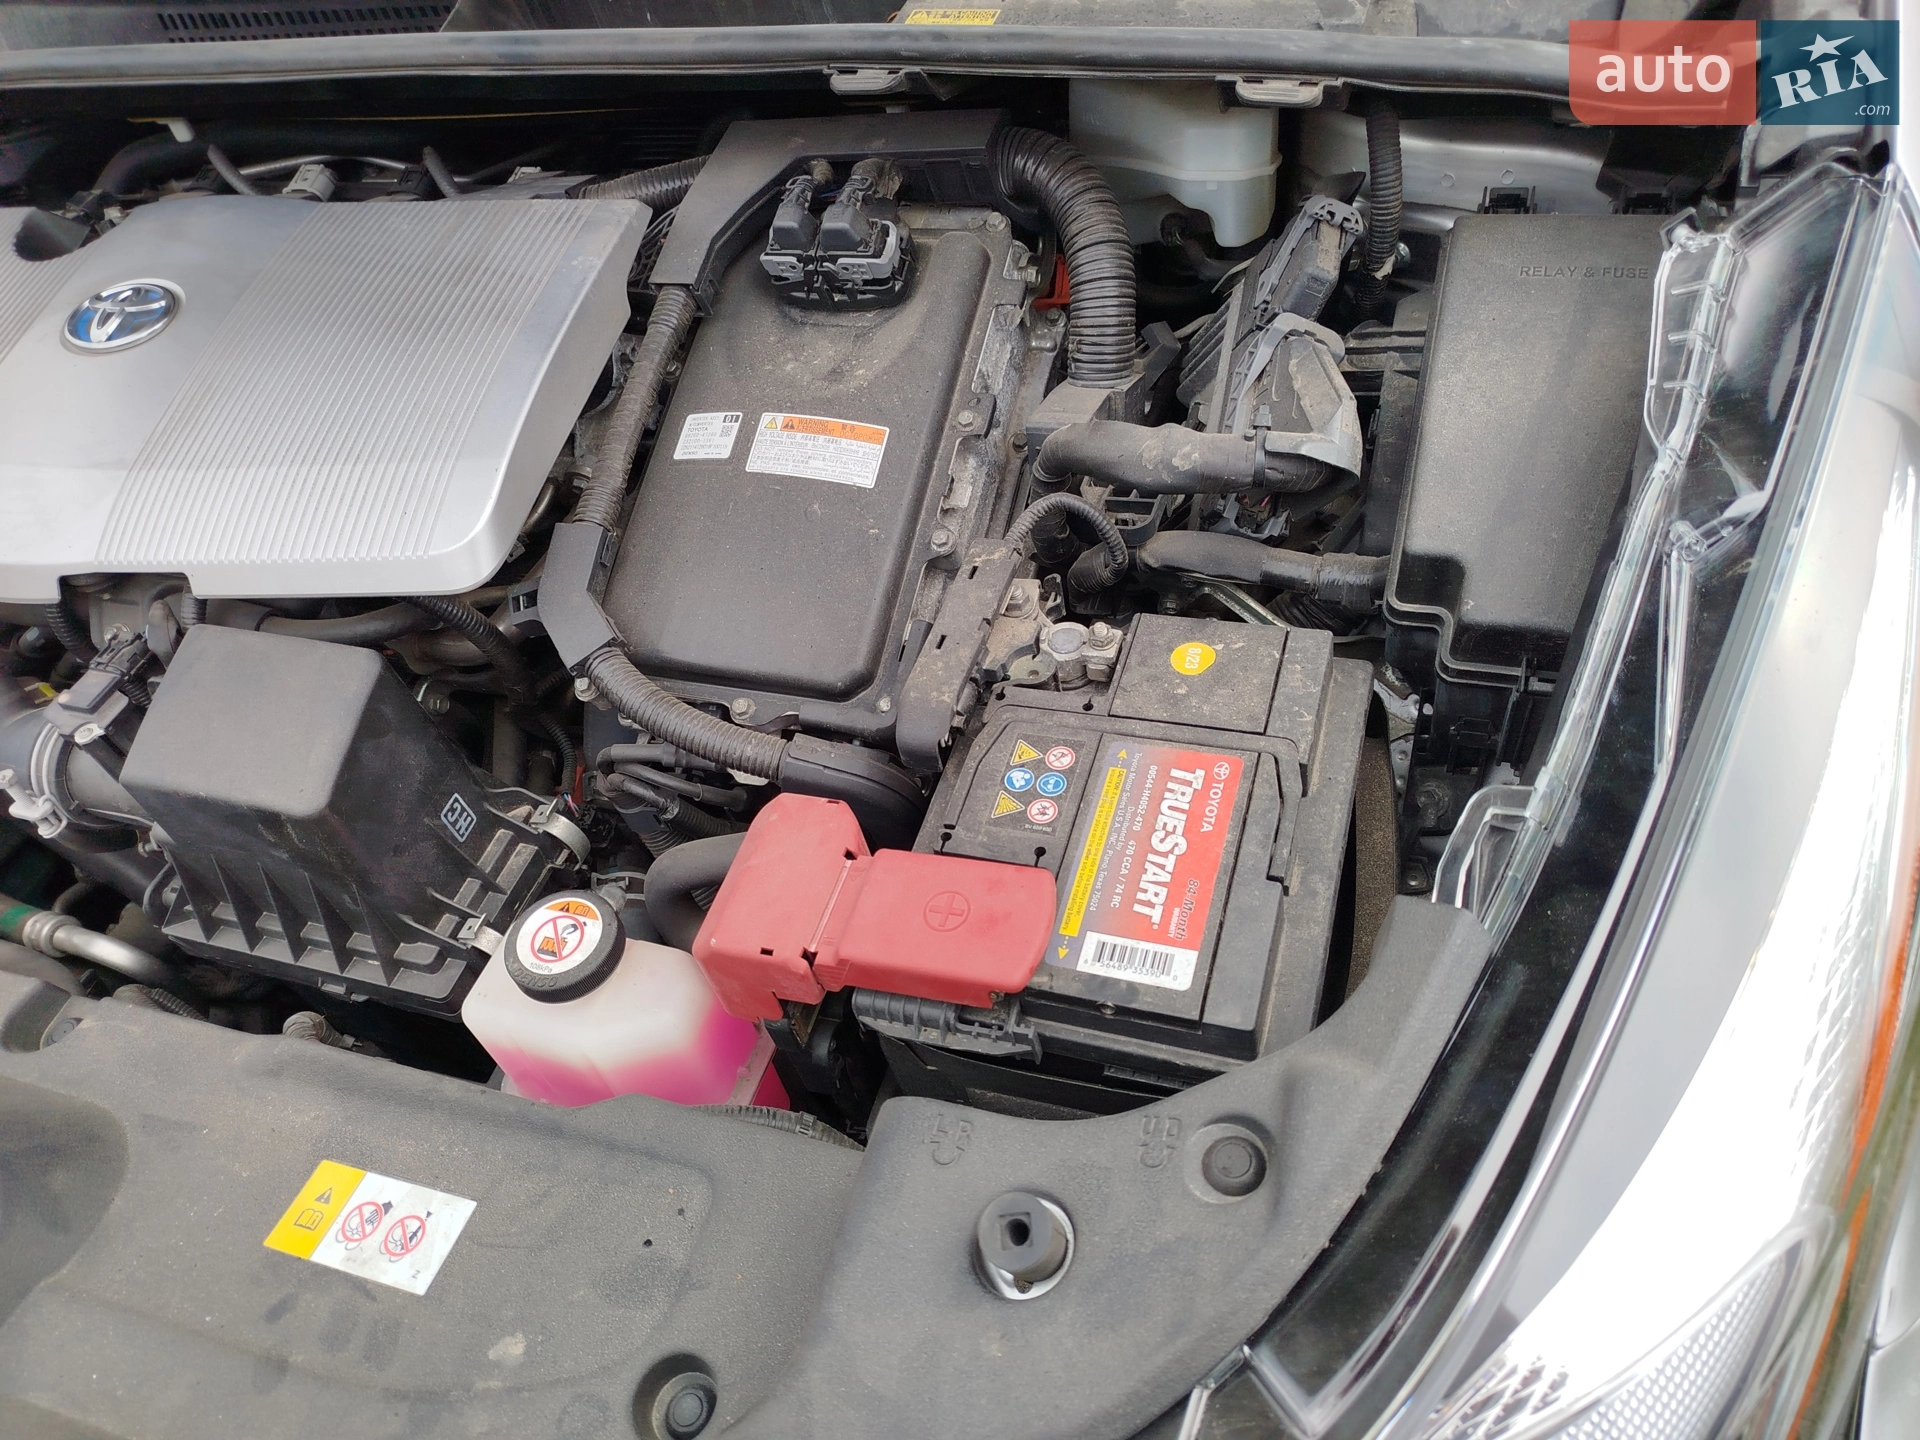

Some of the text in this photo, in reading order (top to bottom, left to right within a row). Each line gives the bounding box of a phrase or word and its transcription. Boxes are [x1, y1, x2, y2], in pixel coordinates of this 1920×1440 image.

[1519, 265, 1650, 279] RELAY & FUSE
[726, 415, 736, 423] 01
[798, 418, 829, 428] WARNING
[1184, 647, 1203, 669] 8/23
[1128, 751, 1143, 772] Toyota
[1123, 771, 1136, 791] Motor
[1118, 791, 1131, 809] Sales
[1131, 764, 1158, 831] 00544-H4052-470
[1199, 780, 1224, 833] TOYOTA
[1113, 805, 1135, 851] Distributed by
[1124, 839, 1137, 855] 470
[1099, 848, 1114, 871] Plano,
[1118, 855, 1133, 875] CCA
[1093, 869, 1107, 890] Texas
[1113, 882, 1125, 894] 74
[1087, 889, 1101, 911] 75024
[1108, 894, 1122, 909] RC
[1174, 878, 1200, 940] 84-Month
[1166, 906, 1181, 938] WARRANTY
[513, 968, 559, 988] DENSO
[530, 962, 553, 974] 108kPa
[1100, 961, 1128, 972] 56489
[1132, 966, 1160, 978] 35390
